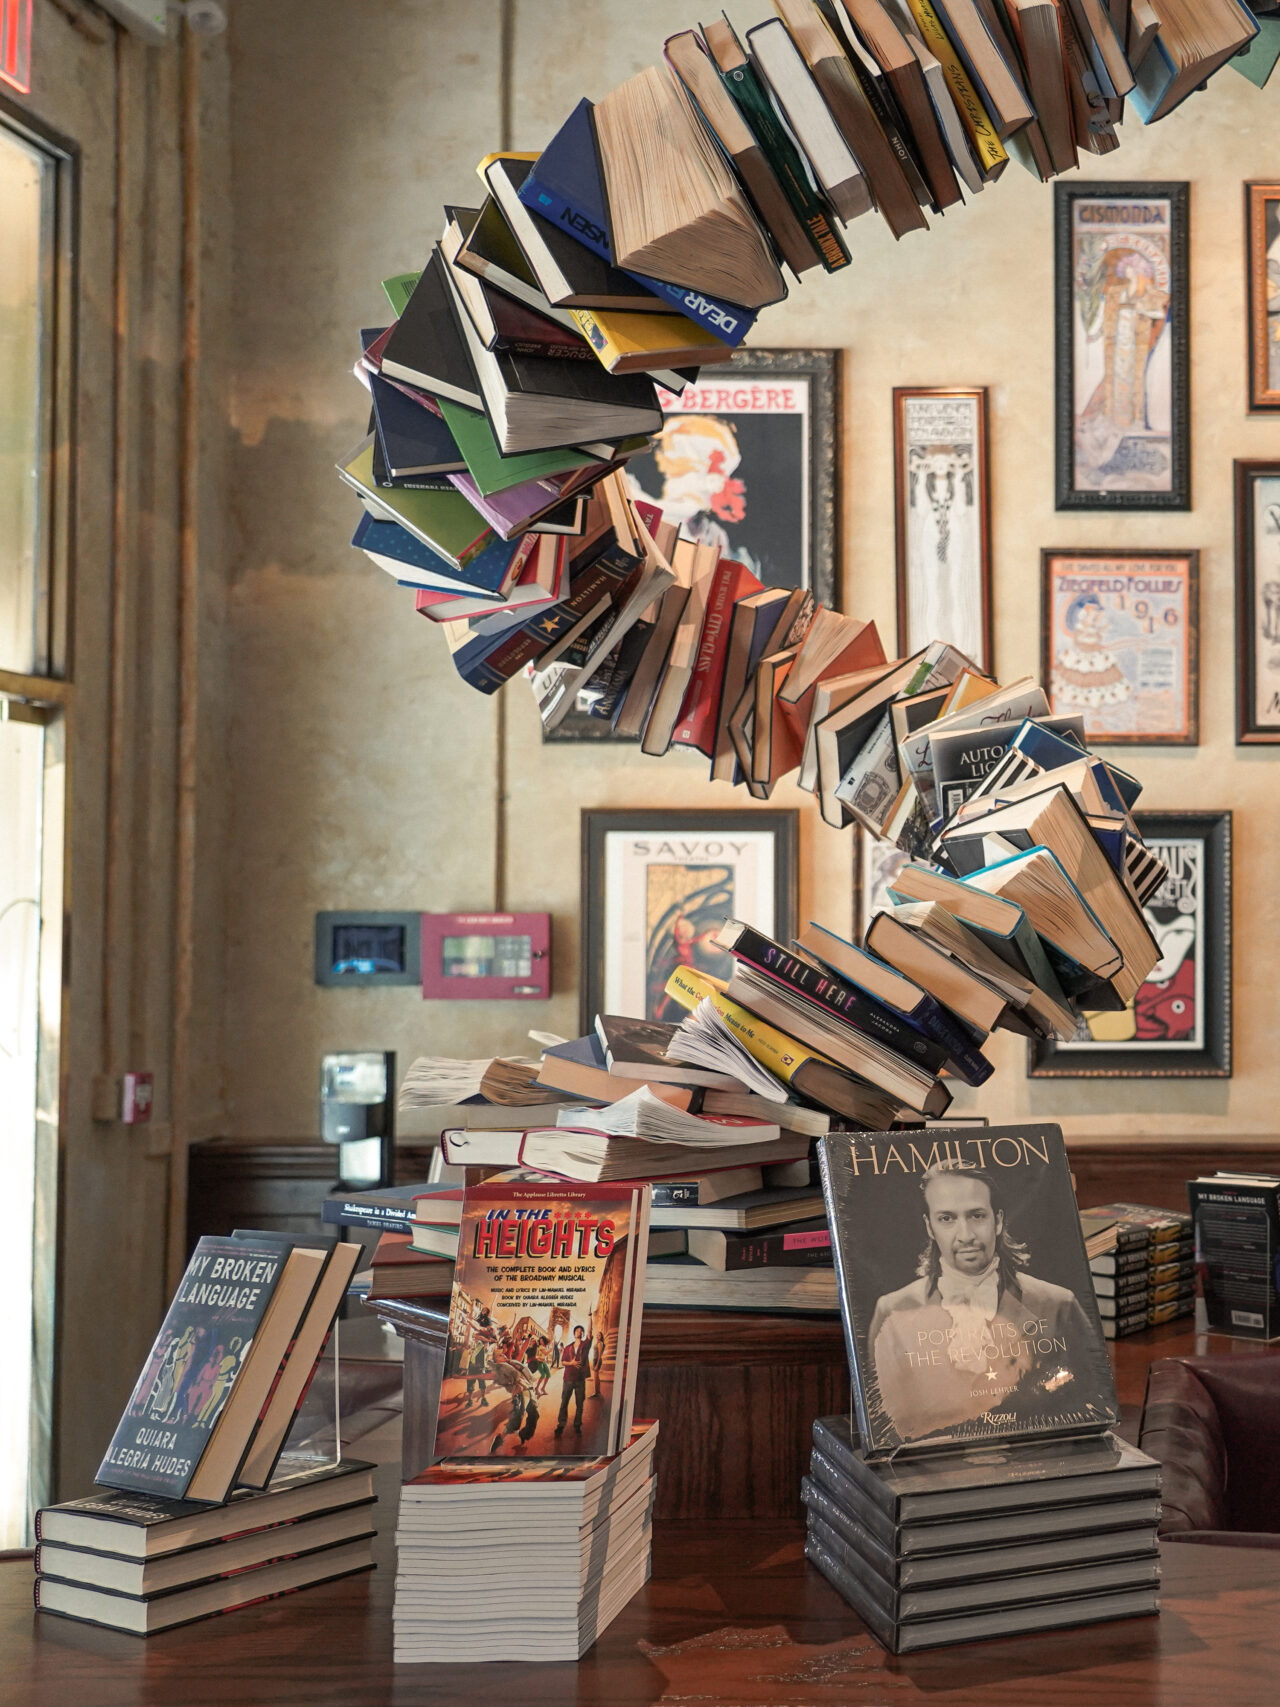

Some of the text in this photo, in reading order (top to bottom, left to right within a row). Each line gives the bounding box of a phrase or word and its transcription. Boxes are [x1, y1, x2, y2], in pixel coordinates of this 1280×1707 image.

[949, 63, 991, 138] CHRISTIANS
[891, 136, 907, 160] JOHN
[560, 207, 610, 250] NSEN
[806, 213, 847, 268] A BRONX TALE
[684, 291, 738, 334] DEAR
[571, 575, 606, 607] HAMILTON
[705, 612, 723, 635] CITY
[696, 641, 715, 673] GLASS
[632, 841, 750, 857] SAVOY
[673, 975, 689, 991] What
[686, 985, 696, 997] the
[763, 948, 857, 1012] STILL HERE
[850, 1135, 1050, 1176] HAMILTON
[343, 1203, 373, 1215] Shakespeare
[386, 1208, 405, 1217] Divided
[1209, 1193, 1233, 1202] BROKEN
[1234, 1195, 1265, 1205] LANGUAGE
[486, 1209, 552, 1220] IN THE
[473, 1219, 616, 1259] HEIGHTS
[185, 1256, 278, 1284] MY BROKEN
[178, 1282, 261, 1310] LANGUAGE
[917, 1319, 1049, 1346] PORTRAITS OF
[904, 1337, 1067, 1367] THE REVOLUTION
[969, 1385, 1019, 1397] JOSH LEHRER
[980, 1411, 1017, 1425] RIZZOLI
[135, 1427, 177, 1450] QUIARA
[151, 1454, 191, 1477] HUDES
